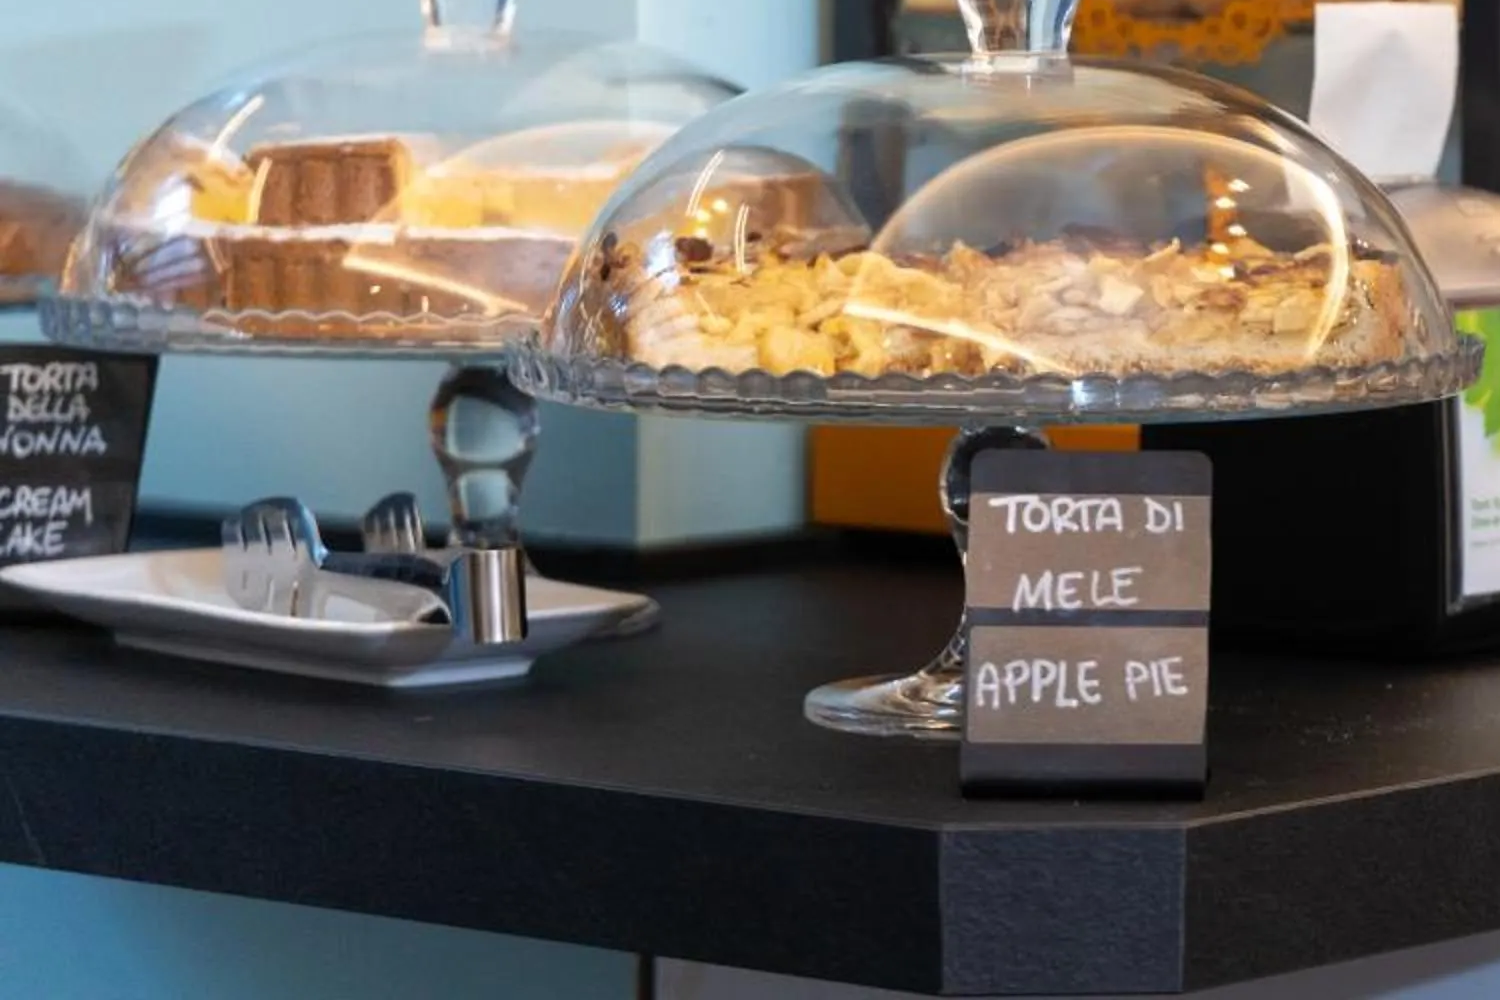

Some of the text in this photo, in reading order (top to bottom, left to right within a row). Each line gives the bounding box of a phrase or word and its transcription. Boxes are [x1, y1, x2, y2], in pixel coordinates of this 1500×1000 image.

[0, 361, 98, 394] TORTA
[7, 393, 91, 423] DELLA
[989, 494, 1184, 535] TORTA DI
[0, 520, 69, 557] AKE
[1012, 567, 1143, 611] MELE
[974, 657, 1188, 710] APPLE PIE
